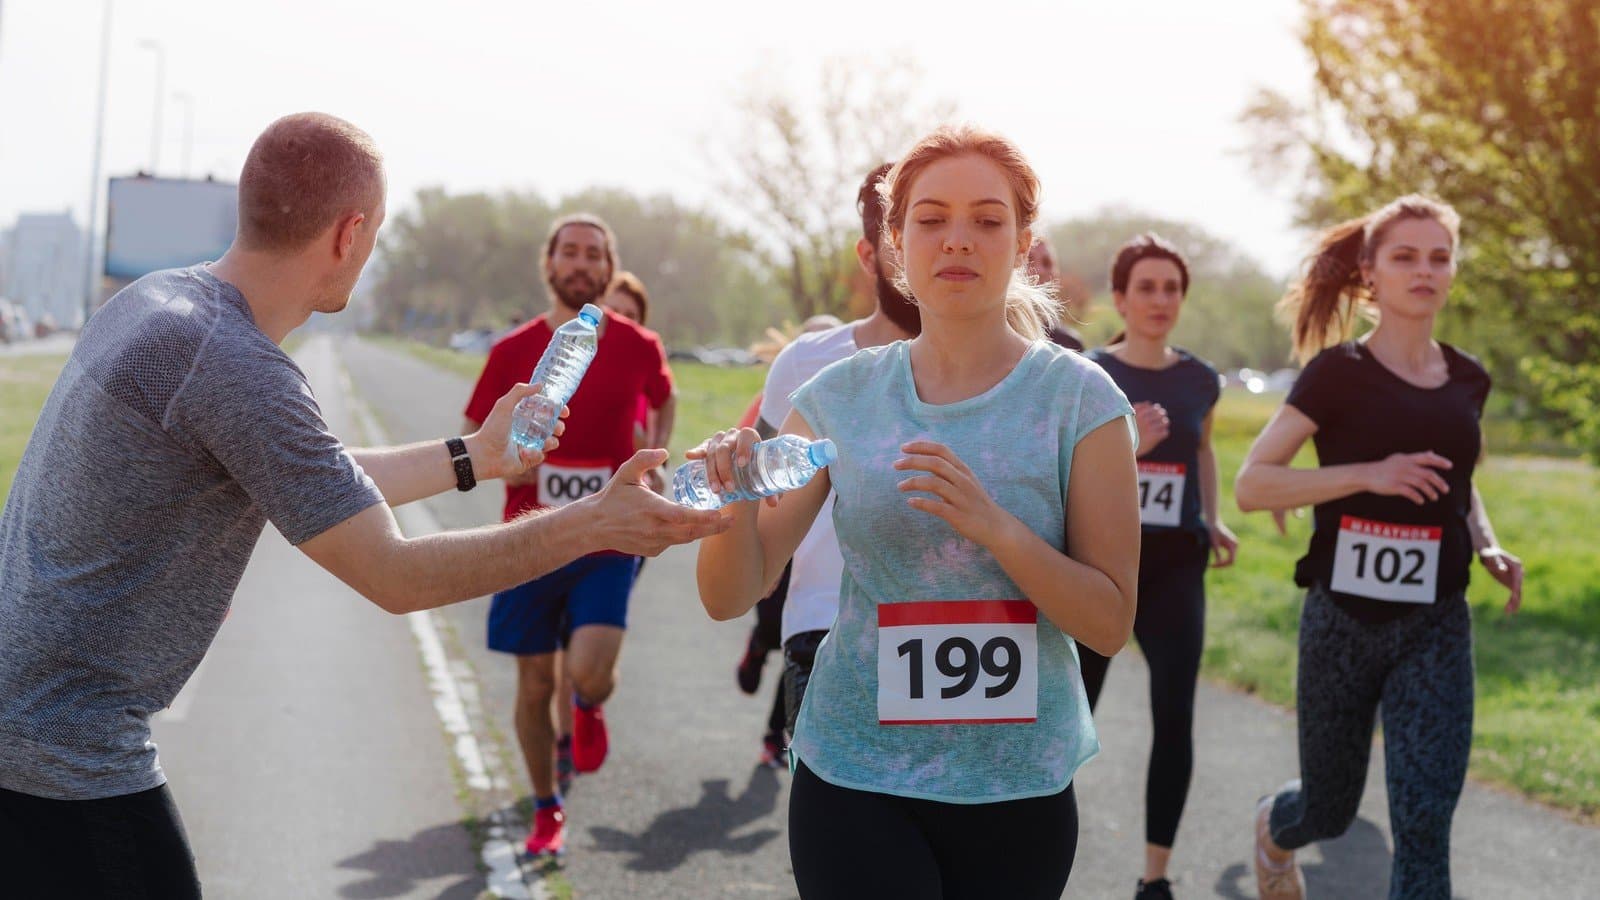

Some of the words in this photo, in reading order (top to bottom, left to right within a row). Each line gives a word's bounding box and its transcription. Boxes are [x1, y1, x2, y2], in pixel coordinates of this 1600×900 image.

[547, 473, 602, 500] 009
[1351, 520, 1430, 538] MARATHON
[1352, 542, 1425, 585] 102
[897, 636, 1022, 700] 199
